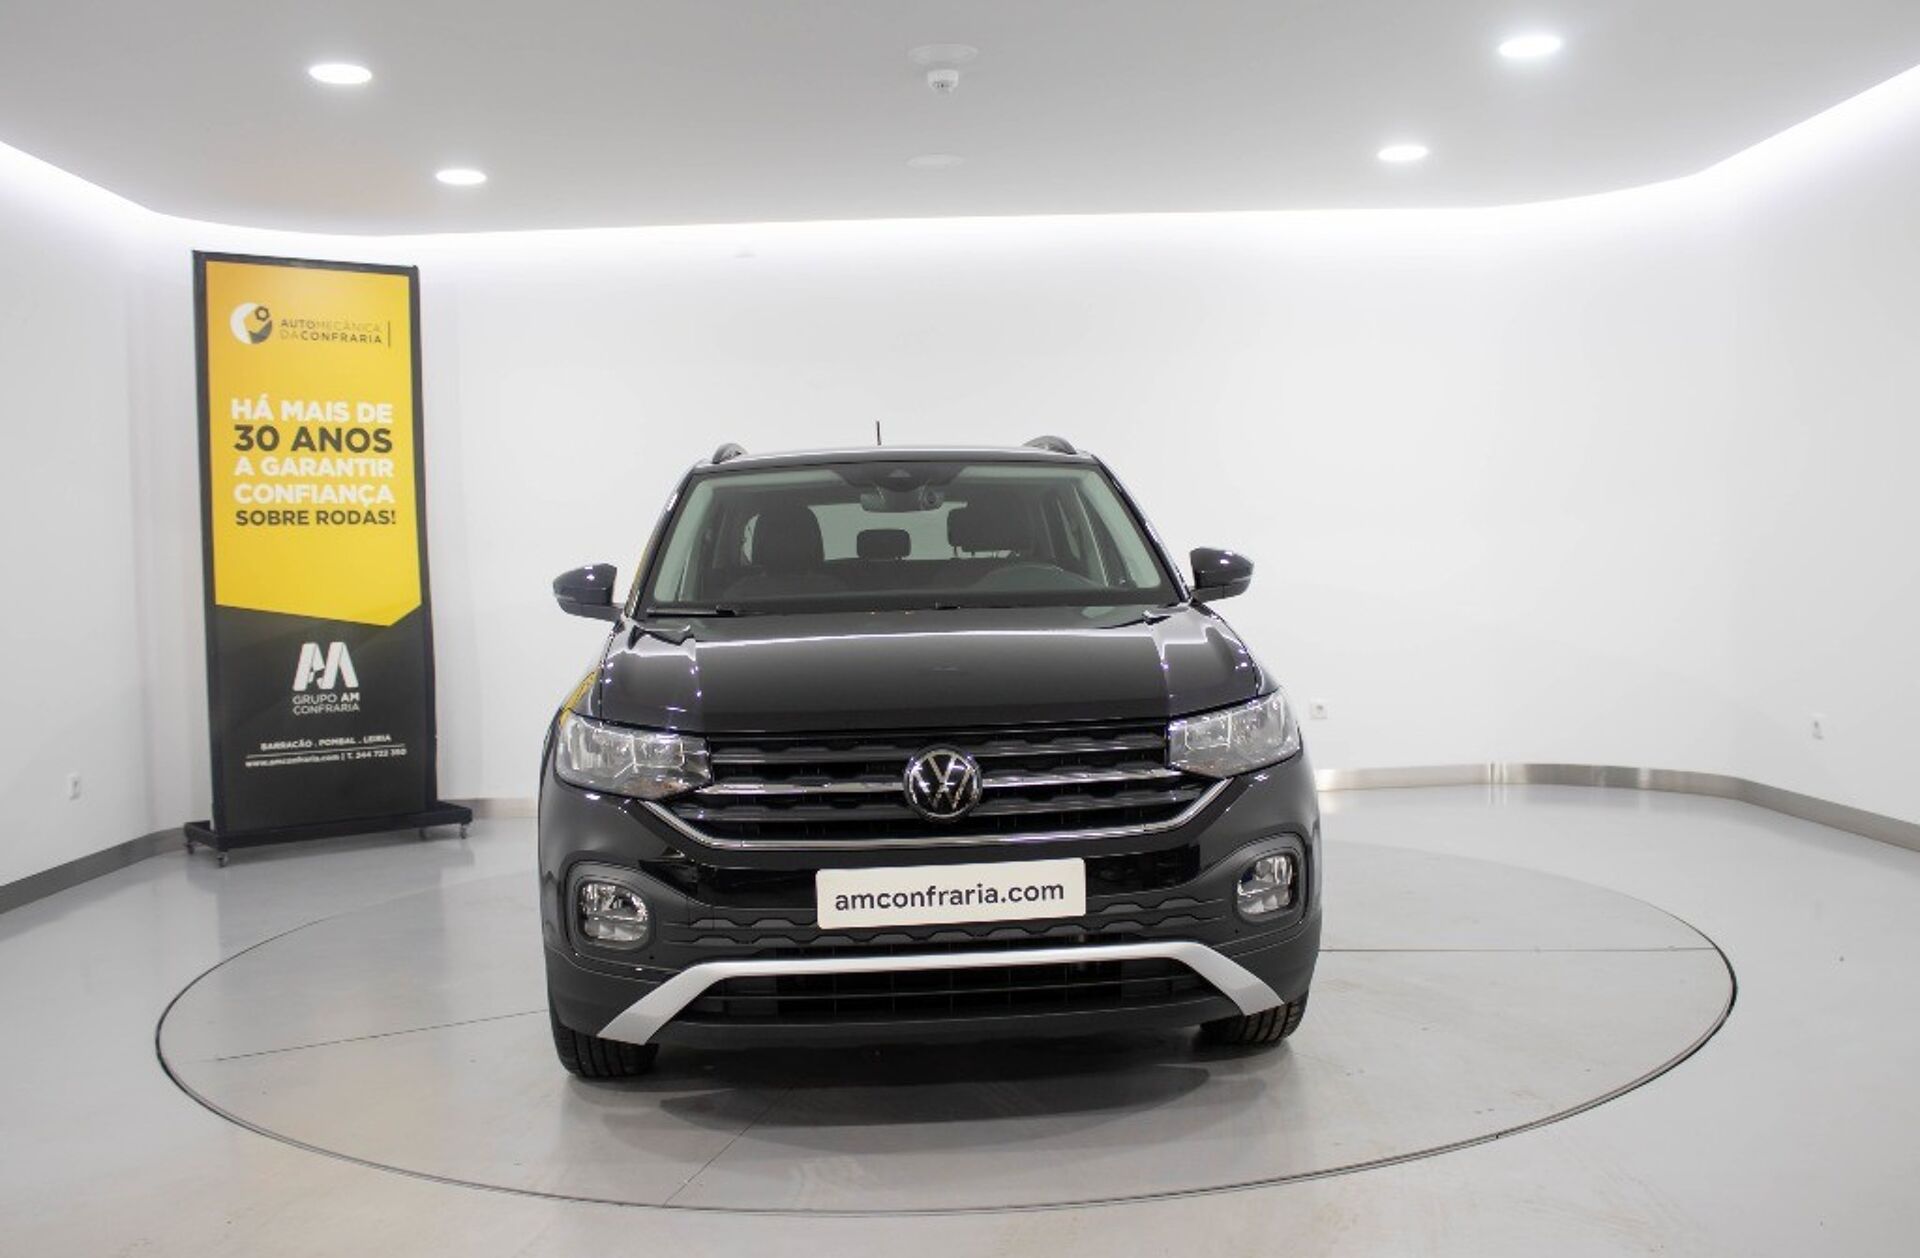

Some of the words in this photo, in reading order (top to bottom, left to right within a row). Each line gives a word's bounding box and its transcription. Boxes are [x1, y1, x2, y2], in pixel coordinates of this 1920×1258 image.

[231, 393, 274, 421] HÁ
[280, 400, 350, 422] MAIS
[356, 402, 393, 424] DE
[233, 424, 280, 452] 30
[290, 426, 393, 453] ANOS
[234, 457, 255, 476] A
[260, 457, 394, 477] GARANTIR
[234, 483, 395, 507] CONFIANÇA
[235, 509, 310, 526] SOBRE
[316, 510, 396, 525] RODAS!
[292, 693, 338, 705] GRUPO
[340, 692, 361, 703] AM
[292, 703, 361, 716] CONFRARIA
[835, 882, 1065, 911] amconfraria.com
